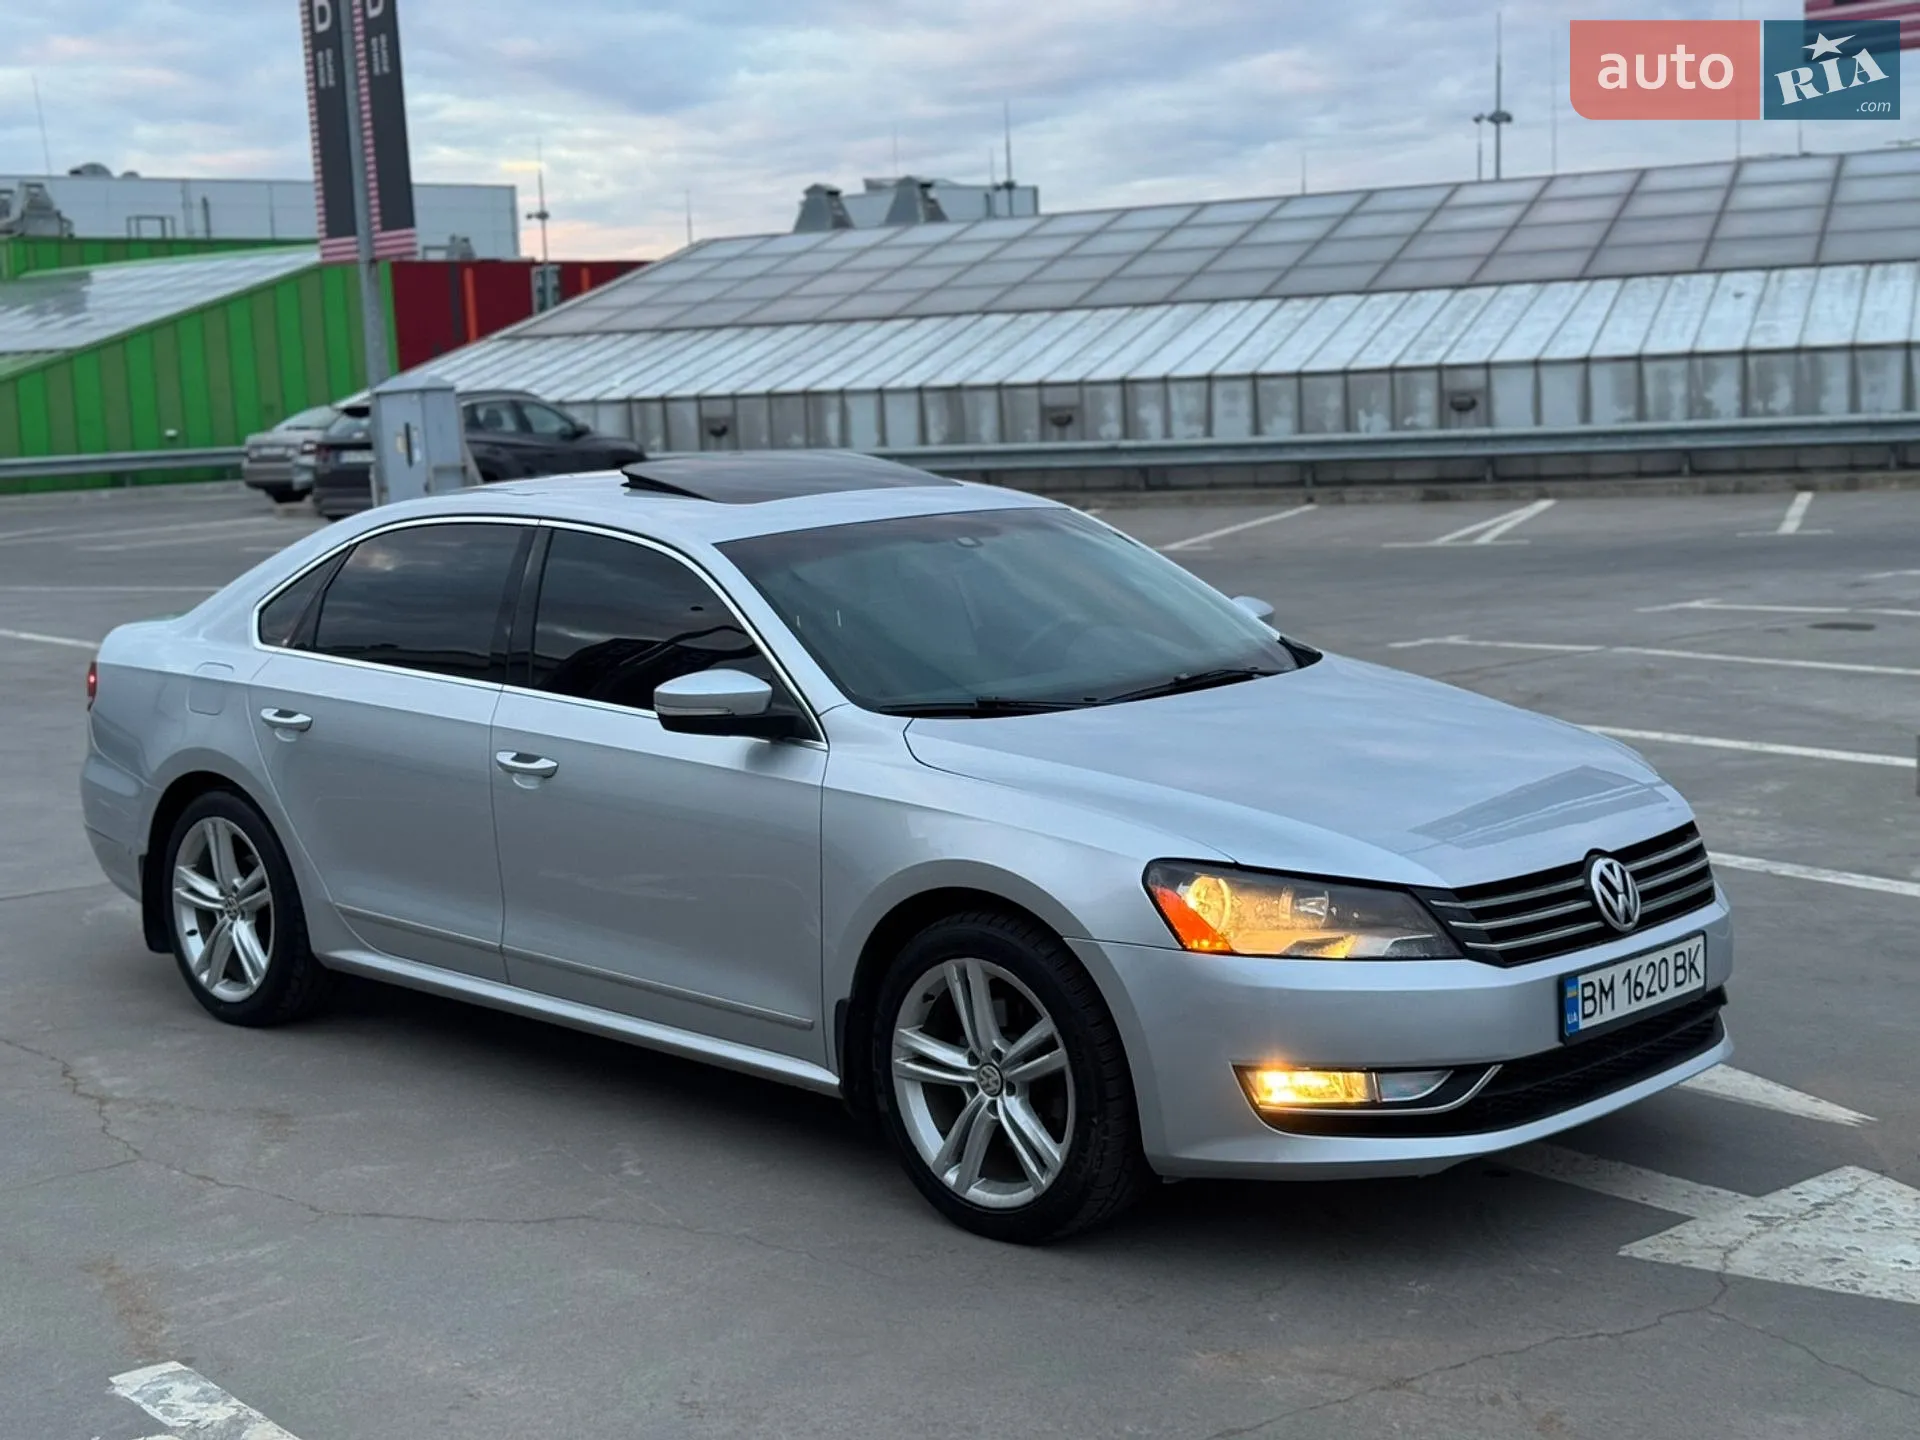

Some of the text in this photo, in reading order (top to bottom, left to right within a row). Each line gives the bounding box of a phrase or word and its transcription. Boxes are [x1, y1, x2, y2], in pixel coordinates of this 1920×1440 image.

[1592, 859, 1640, 931] VW
[1581, 944, 1701, 1020] BM 1620 BK
